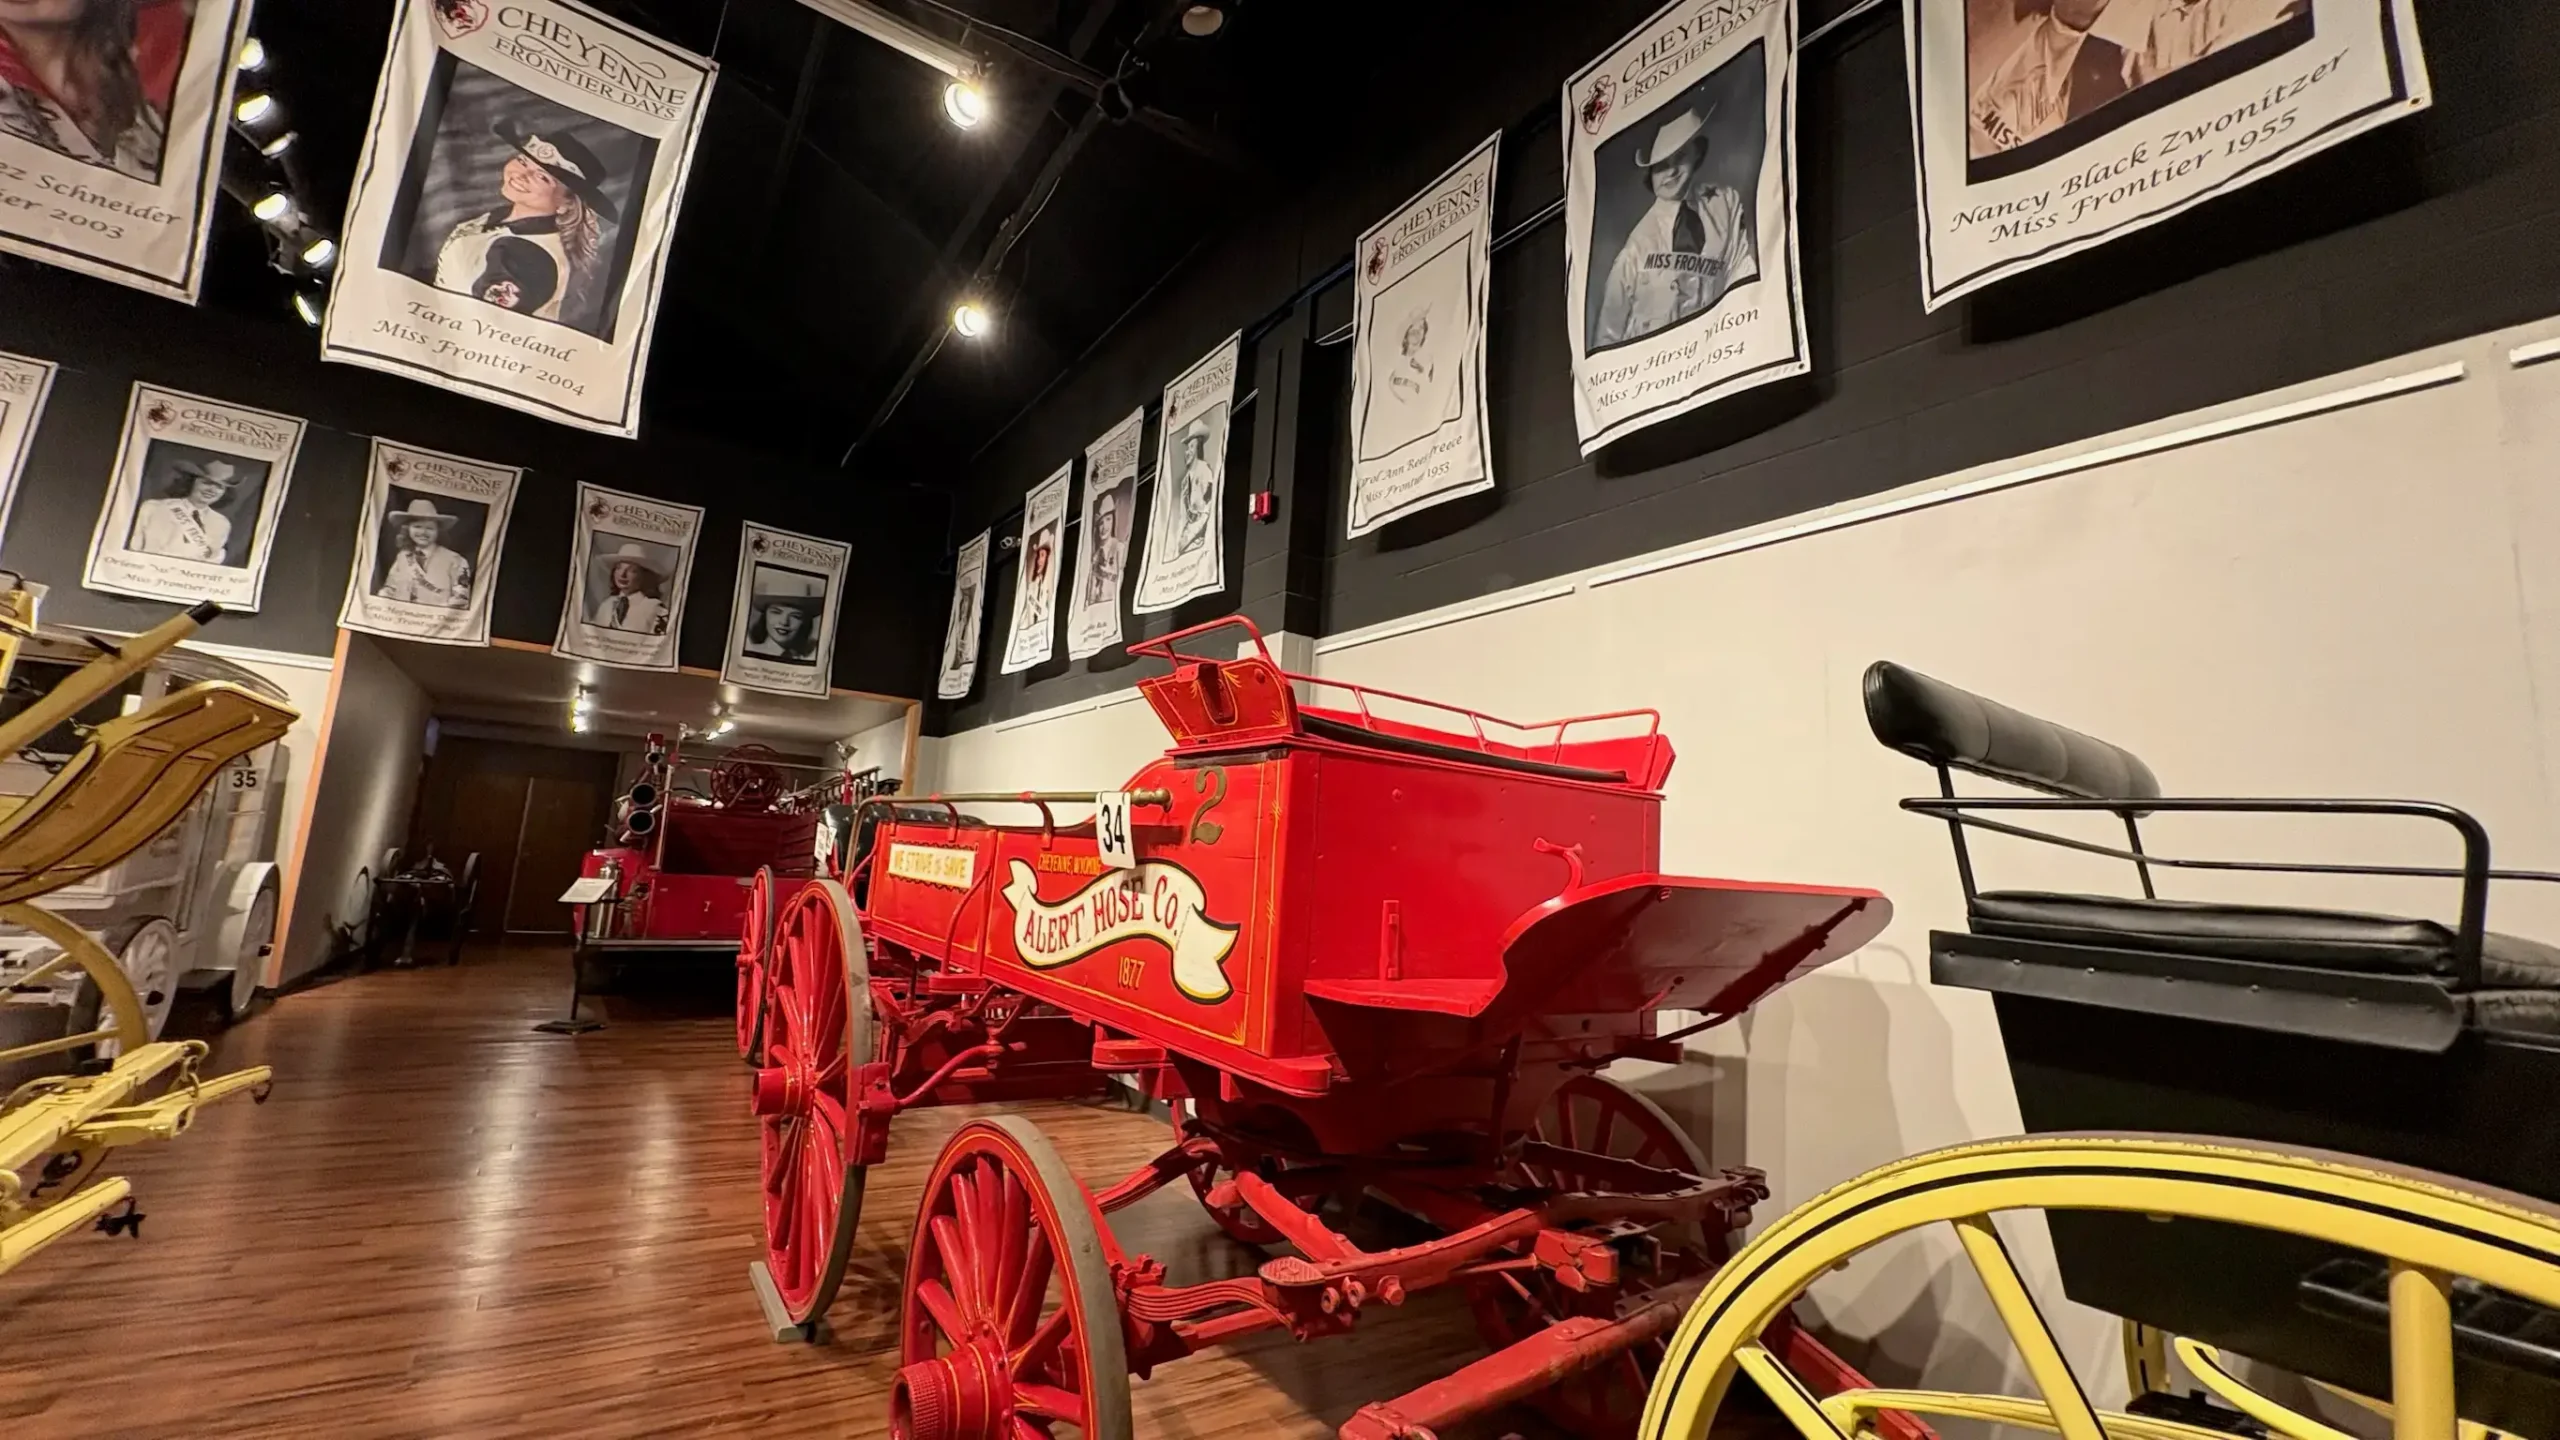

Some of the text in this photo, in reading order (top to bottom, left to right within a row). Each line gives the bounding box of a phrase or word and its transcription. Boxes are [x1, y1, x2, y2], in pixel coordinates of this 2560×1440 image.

[495, 38, 677, 120] FRONTIER DAYS
[498, 7, 687, 105] CHEYENNE
[1624, 36, 1713, 105] FRONTIER
[1950, 46, 2350, 233] Nancy Black Zwonitzer
[1981, 110, 2023, 150] MISS
[36, 174, 182, 225] Schneider
[1988, 106, 2300, 244] Miss Frontier 1955
[50, 208, 125, 240] 2003
[1391, 172, 1485, 246] CHEYENNE
[1391, 196, 1480, 266] FRONTIER DAYS
[1644, 253, 1673, 270] MISS
[372, 319, 585, 396] Miss Frontier 2004
[407, 301, 577, 363] Tara Vreeland
[1587, 363, 1640, 392] Margy
[1643, 340, 1698, 371] Hirsig
[1596, 340, 1746, 411] Miss Frontier 1954
[181, 408, 290, 442] CHEYENNE
[414, 461, 501, 489] CHEYENNE
[1427, 461, 1450, 478] 1953
[613, 504, 692, 530] CHEYENNE
[773, 539, 841, 563] CHEYENNE
[232, 770, 257, 788] 35
[1101, 804, 1126, 855] 34
[1189, 765, 1228, 845] 2
[944, 855, 967, 879] SAVE
[1023, 903, 1085, 954] ALERT
[1092, 876, 1144, 936] HOSE
[1118, 956, 1146, 989] 1877
